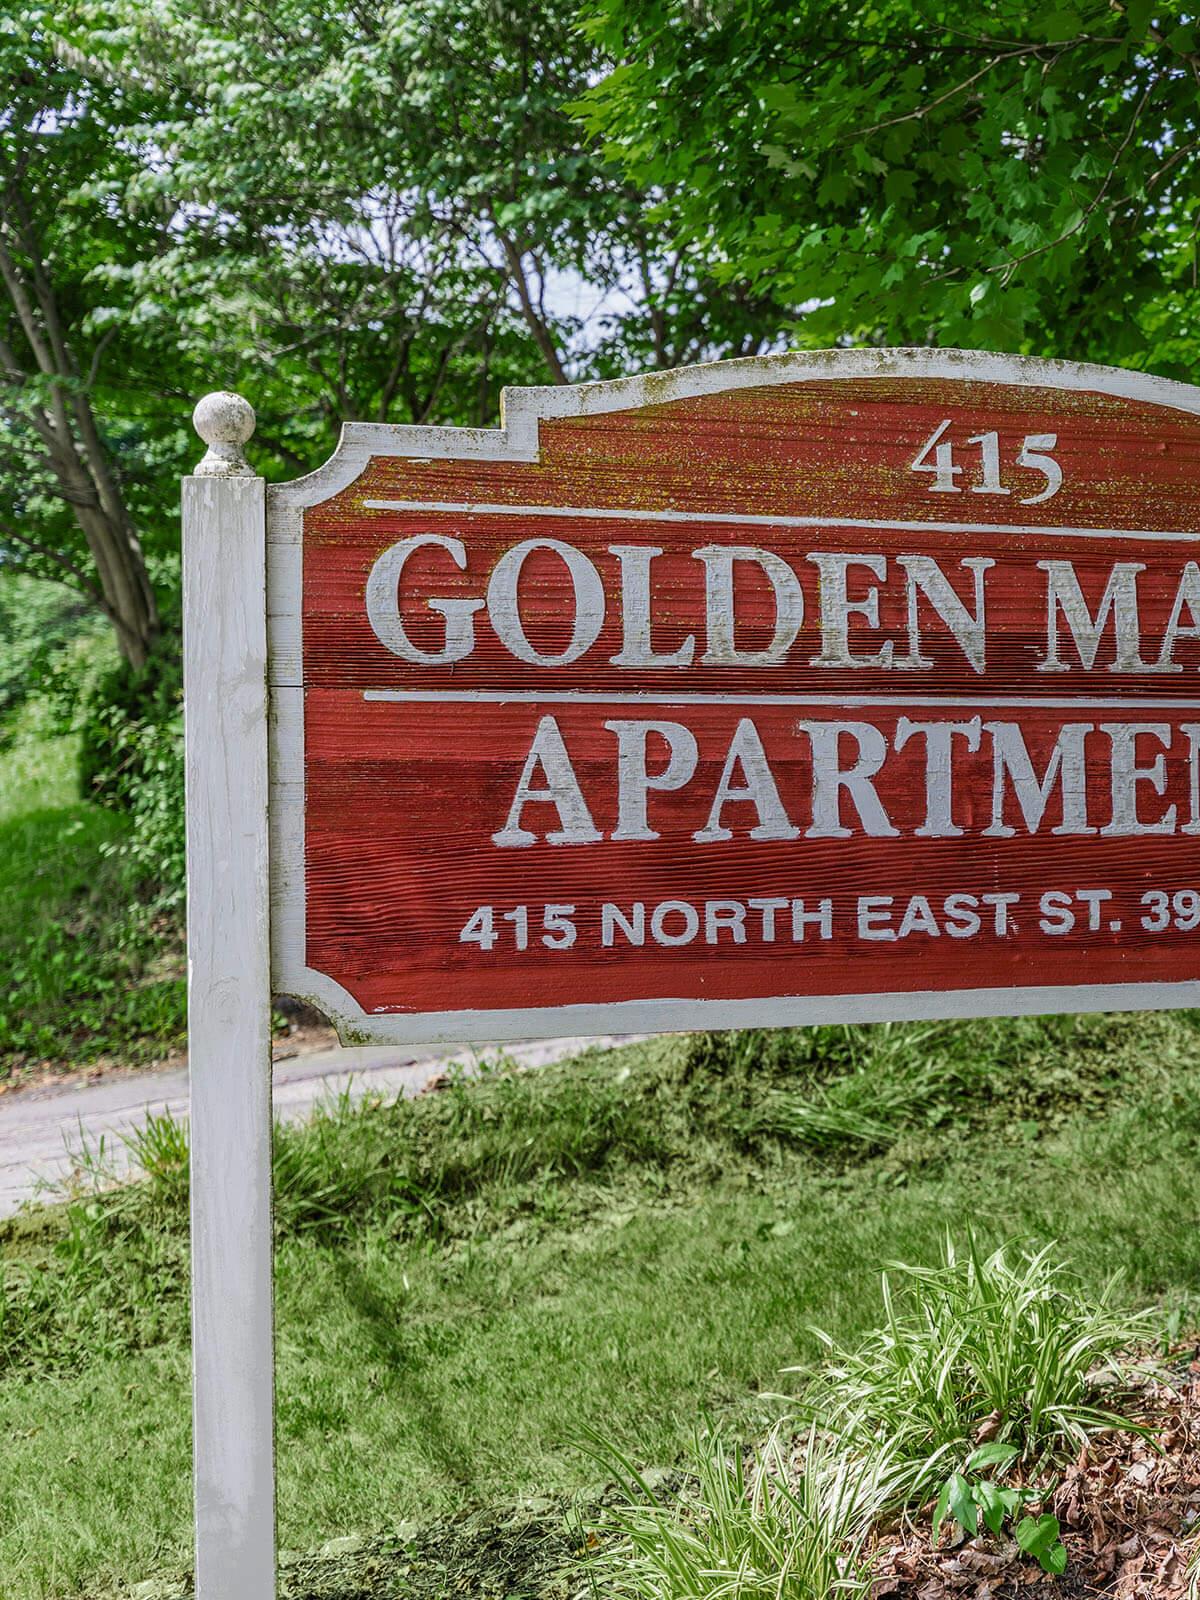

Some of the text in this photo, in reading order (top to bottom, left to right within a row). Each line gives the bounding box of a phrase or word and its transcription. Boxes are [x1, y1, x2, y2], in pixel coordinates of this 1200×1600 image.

[911, 419, 1064, 505] 415
[365, 533, 996, 674] GOLDEN
[459, 905, 578, 951] 415
[601, 898, 832, 947] NORTH
[857, 893, 1020, 941] EAST
[1038, 889, 1122, 936] ST.
